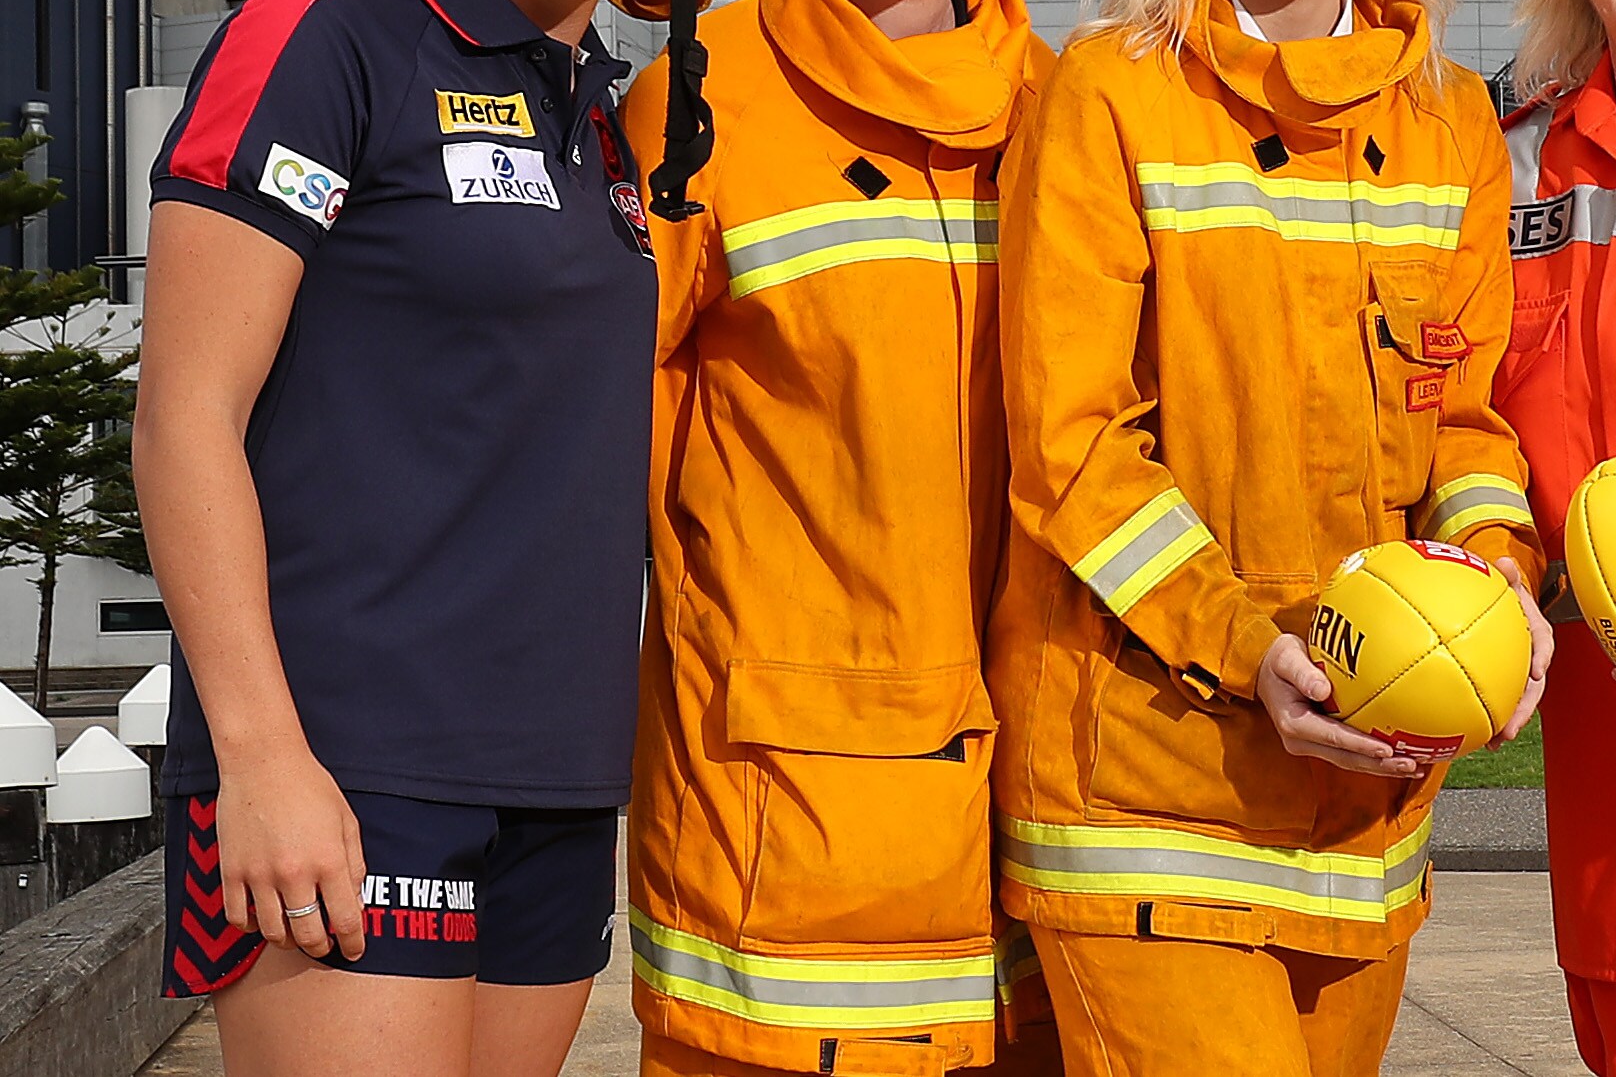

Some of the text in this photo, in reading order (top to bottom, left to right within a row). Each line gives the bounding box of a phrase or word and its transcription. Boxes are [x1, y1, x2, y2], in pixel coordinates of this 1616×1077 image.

[448, 96, 520, 127] Hertz
[461, 177, 552, 205] ZURICH
[1309, 604, 1365, 676] RIN
[396, 877, 443, 909] THE
[444, 880, 475, 910] GAME
[391, 909, 439, 940] THE
[443, 912, 477, 942] ODDS
